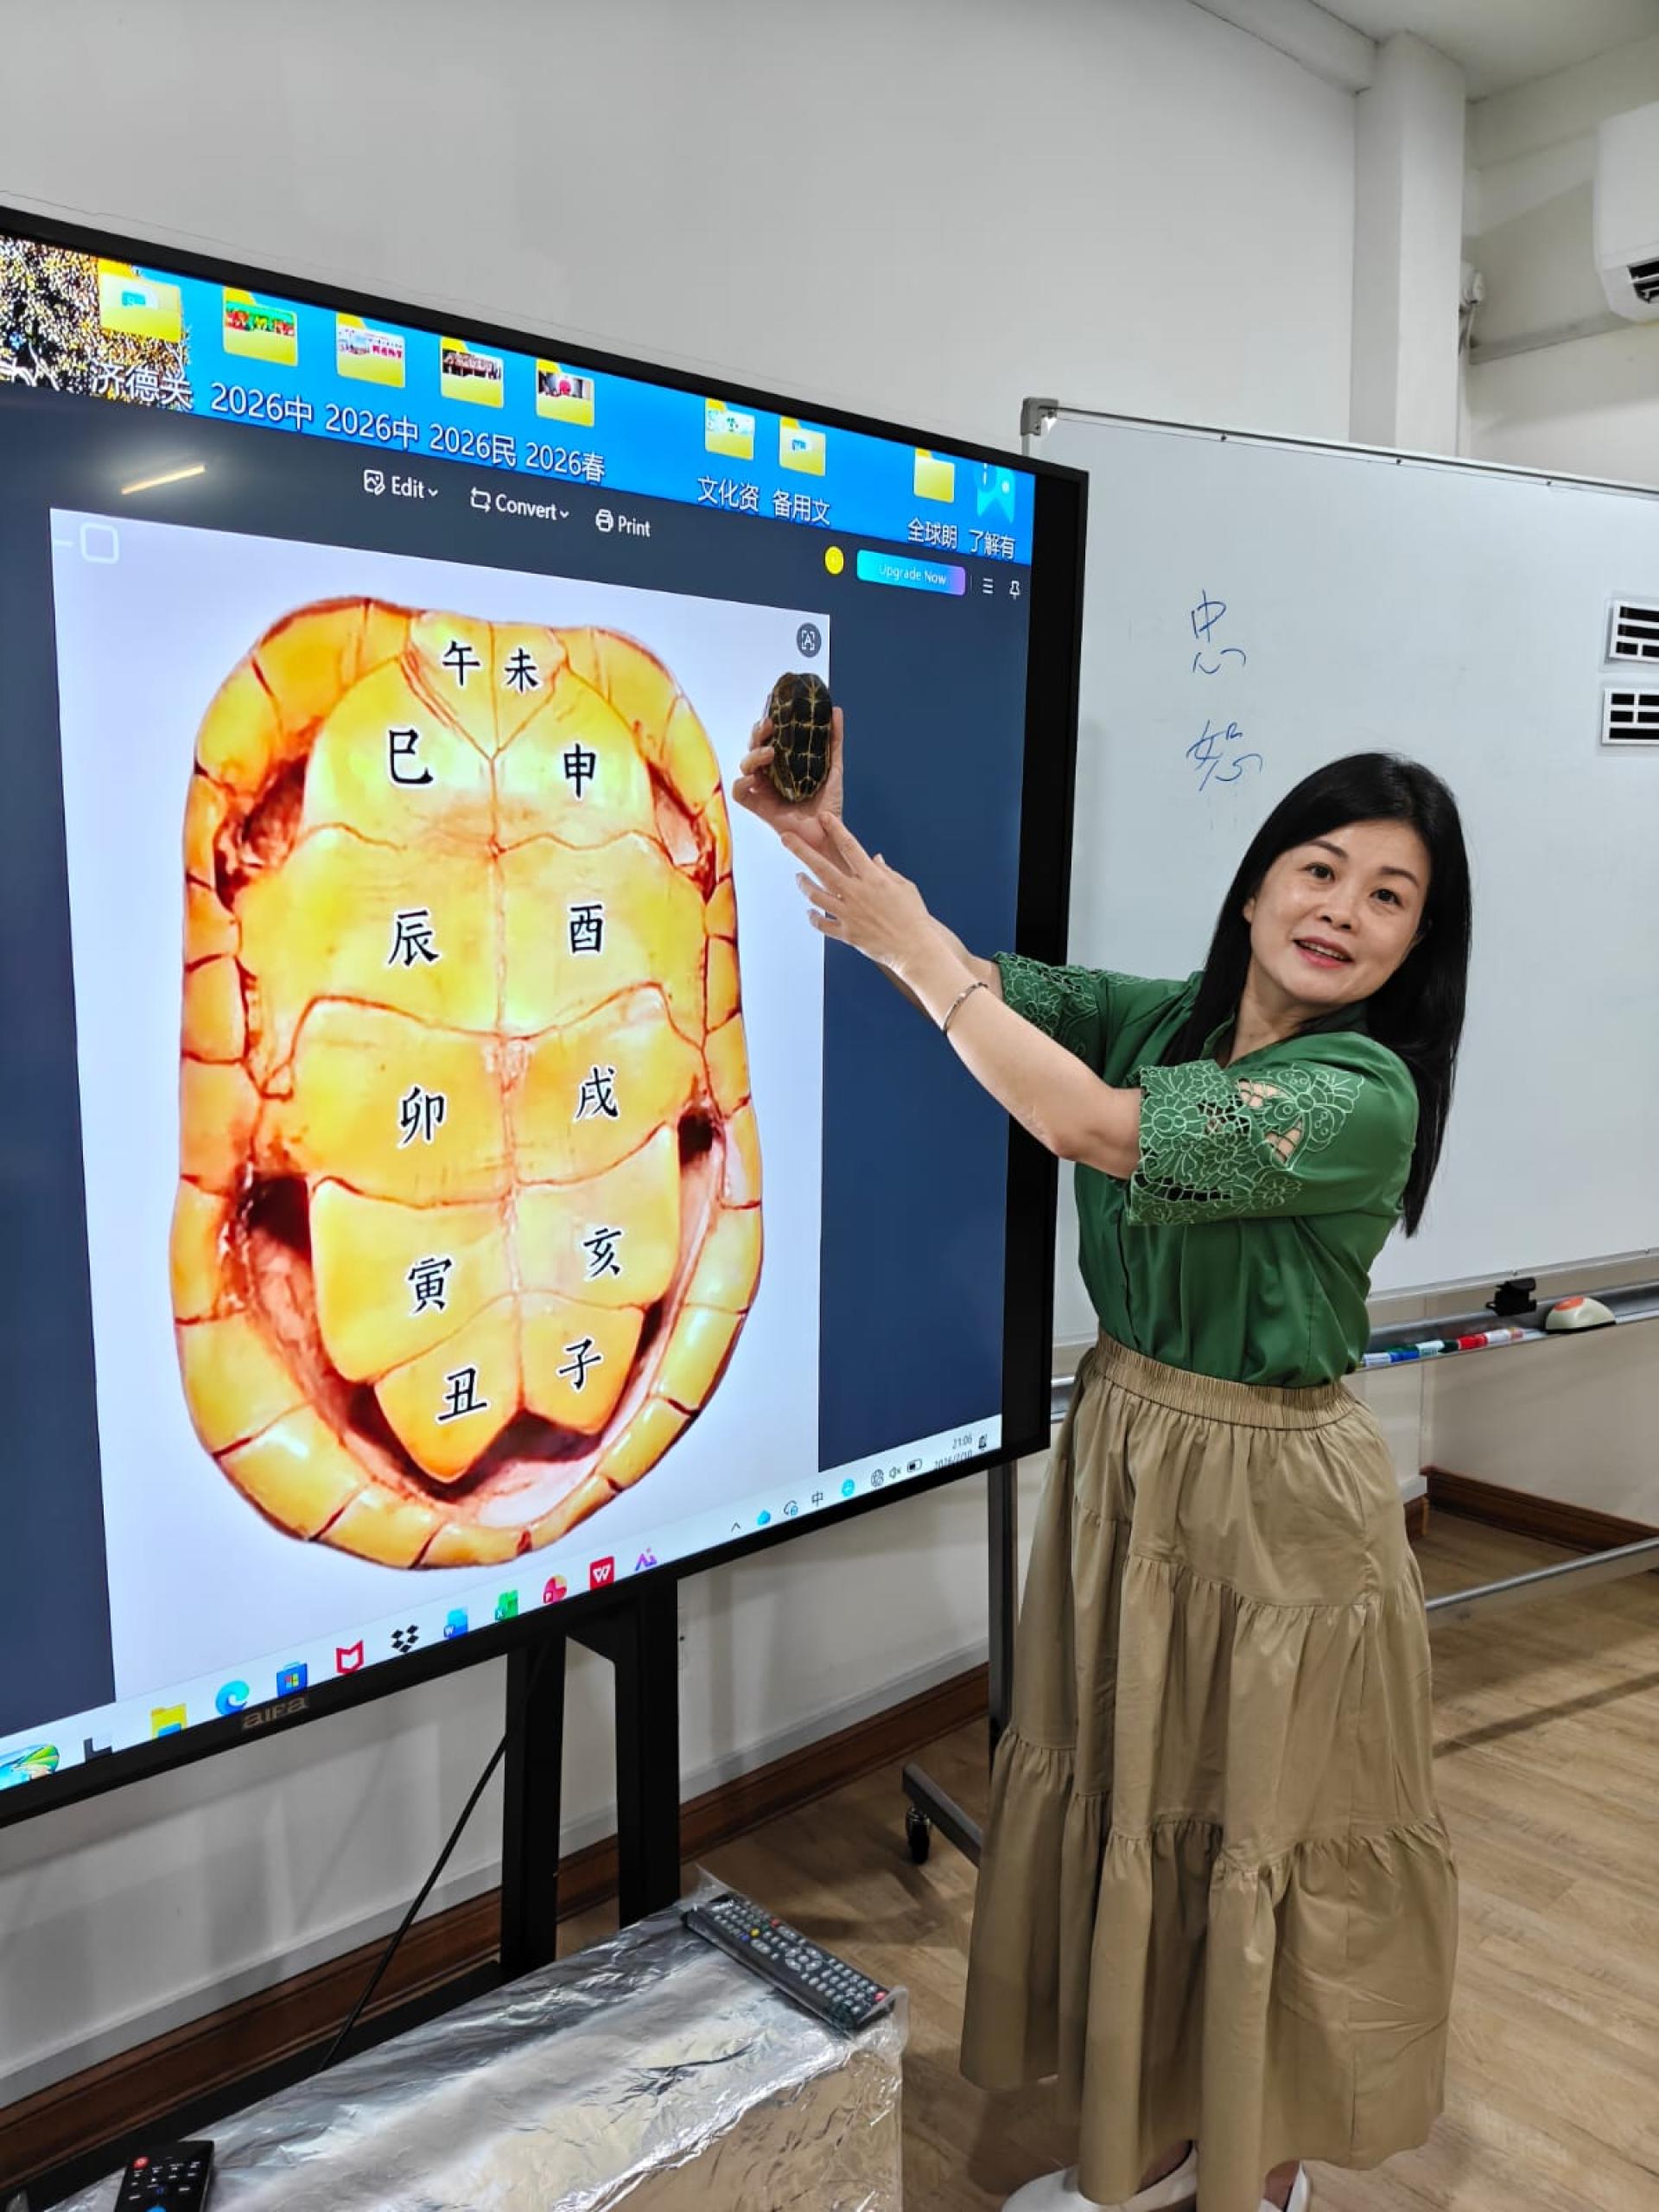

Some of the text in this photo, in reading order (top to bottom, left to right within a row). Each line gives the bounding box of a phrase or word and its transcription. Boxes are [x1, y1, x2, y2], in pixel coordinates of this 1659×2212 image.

[211, 382, 312, 430] 2026中
[325, 403, 419, 448] 2026中
[429, 423, 517, 467] 2026民
[525, 442, 605, 483] 2026春
[391, 476, 425, 499] Edit
[495, 493, 557, 520] Convert
[697, 475, 760, 512] 文化资
[772, 490, 830, 525] 备用文
[618, 517, 651, 537] Print
[908, 518, 957, 549] 全球朗
[968, 529, 1015, 559] 了解有
[879, 563, 947, 585] Upgrade Now
[442, 640, 480, 686] 午
[505, 647, 538, 692] 未
[389, 729, 434, 785] 巳
[563, 743, 596, 798] 申
[388, 911, 440, 966] 辰
[570, 904, 603, 953] 酉
[400, 1087, 444, 1144] 卯
[575, 1067, 618, 1119] 戌
[583, 1228, 621, 1277] 亥
[408, 1258, 452, 1313] 寅
[559, 1338, 601, 1389] 子
[438, 1368, 487, 1421] 丑
[811, 1491, 823, 1507] 中
